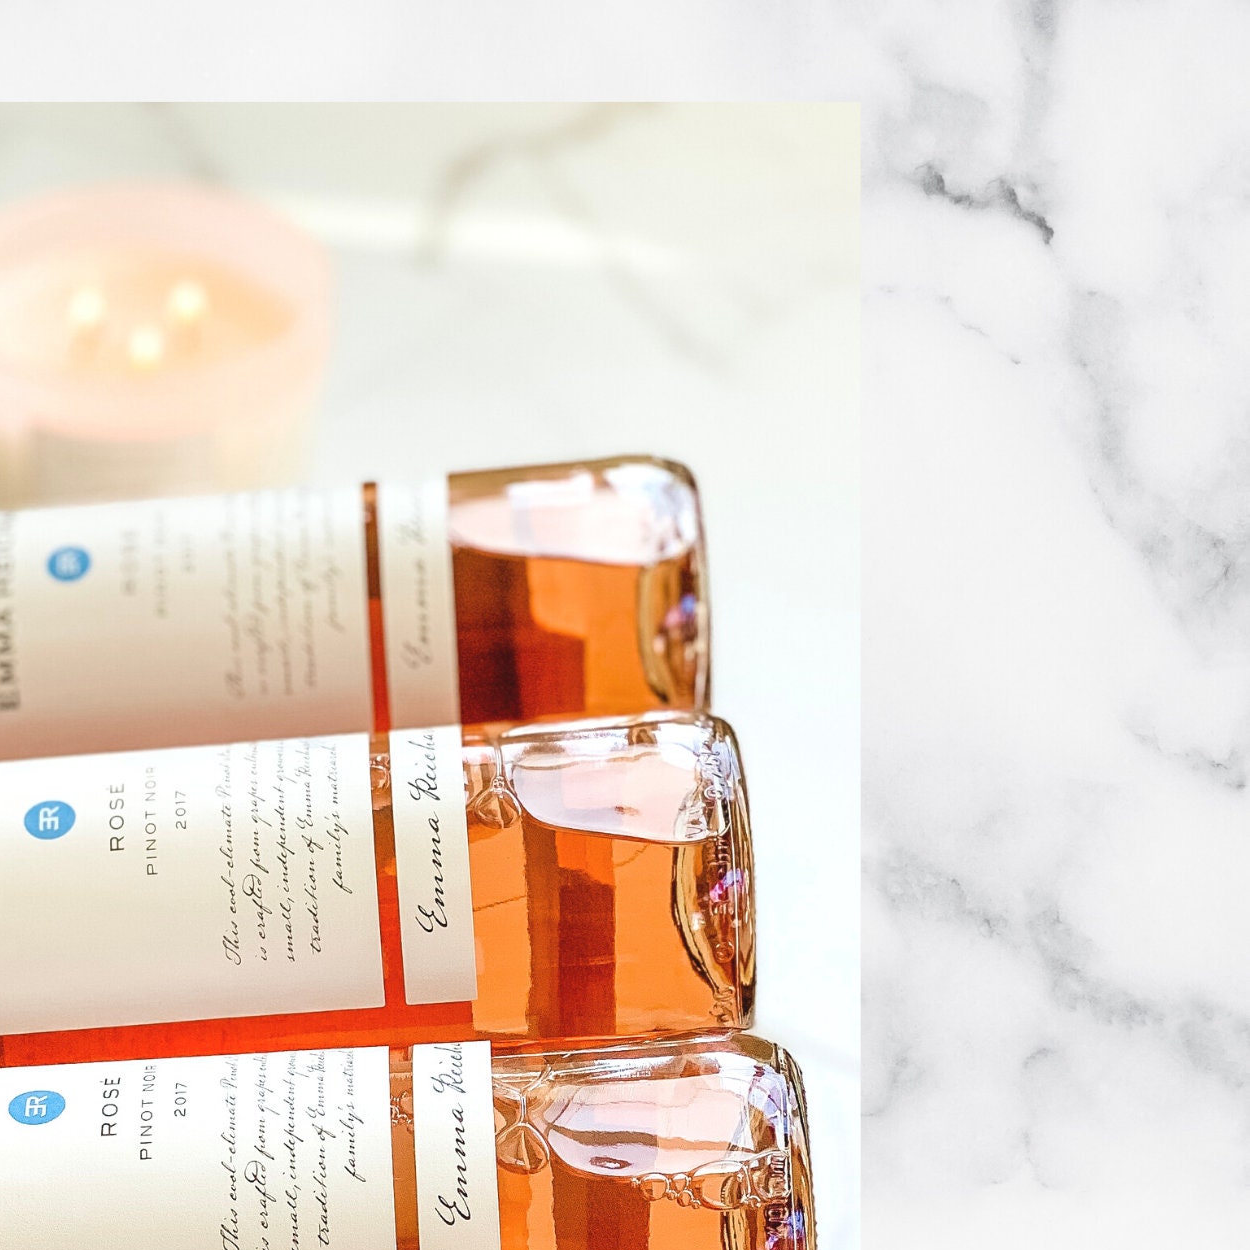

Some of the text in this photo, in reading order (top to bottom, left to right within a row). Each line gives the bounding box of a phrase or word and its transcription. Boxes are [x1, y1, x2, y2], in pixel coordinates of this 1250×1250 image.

[175, 791, 187, 830] 2017
[295, 781, 314, 830] Emma
[145, 811, 158, 876] PINOT
[219, 802, 238, 917] cool-climate
[276, 788, 296, 893] independent
[300, 834, 324, 854] of
[323, 810, 352, 894] family's
[415, 811, 448, 933] Emma
[242, 874, 272, 940] crafted
[280, 898, 296, 962] small,
[302, 854, 322, 955] tradition
[221, 919, 242, 966] This
[254, 945, 268, 962] is
[100, 1077, 121, 1137] ROSÉ
[140, 1065, 157, 1160] PINOT NOIR
[174, 1083, 188, 1117] 2017
[282, 1077, 304, 1182] independent
[305, 1076, 325, 1119] Emma
[221, 1093, 237, 1201] cool-climate
[312, 1122, 336, 1144] of
[338, 1101, 367, 1182] family's
[435, 1101, 471, 1226] Emma
[244, 1160, 276, 1230] crafted
[312, 1145, 330, 1247] tradition
